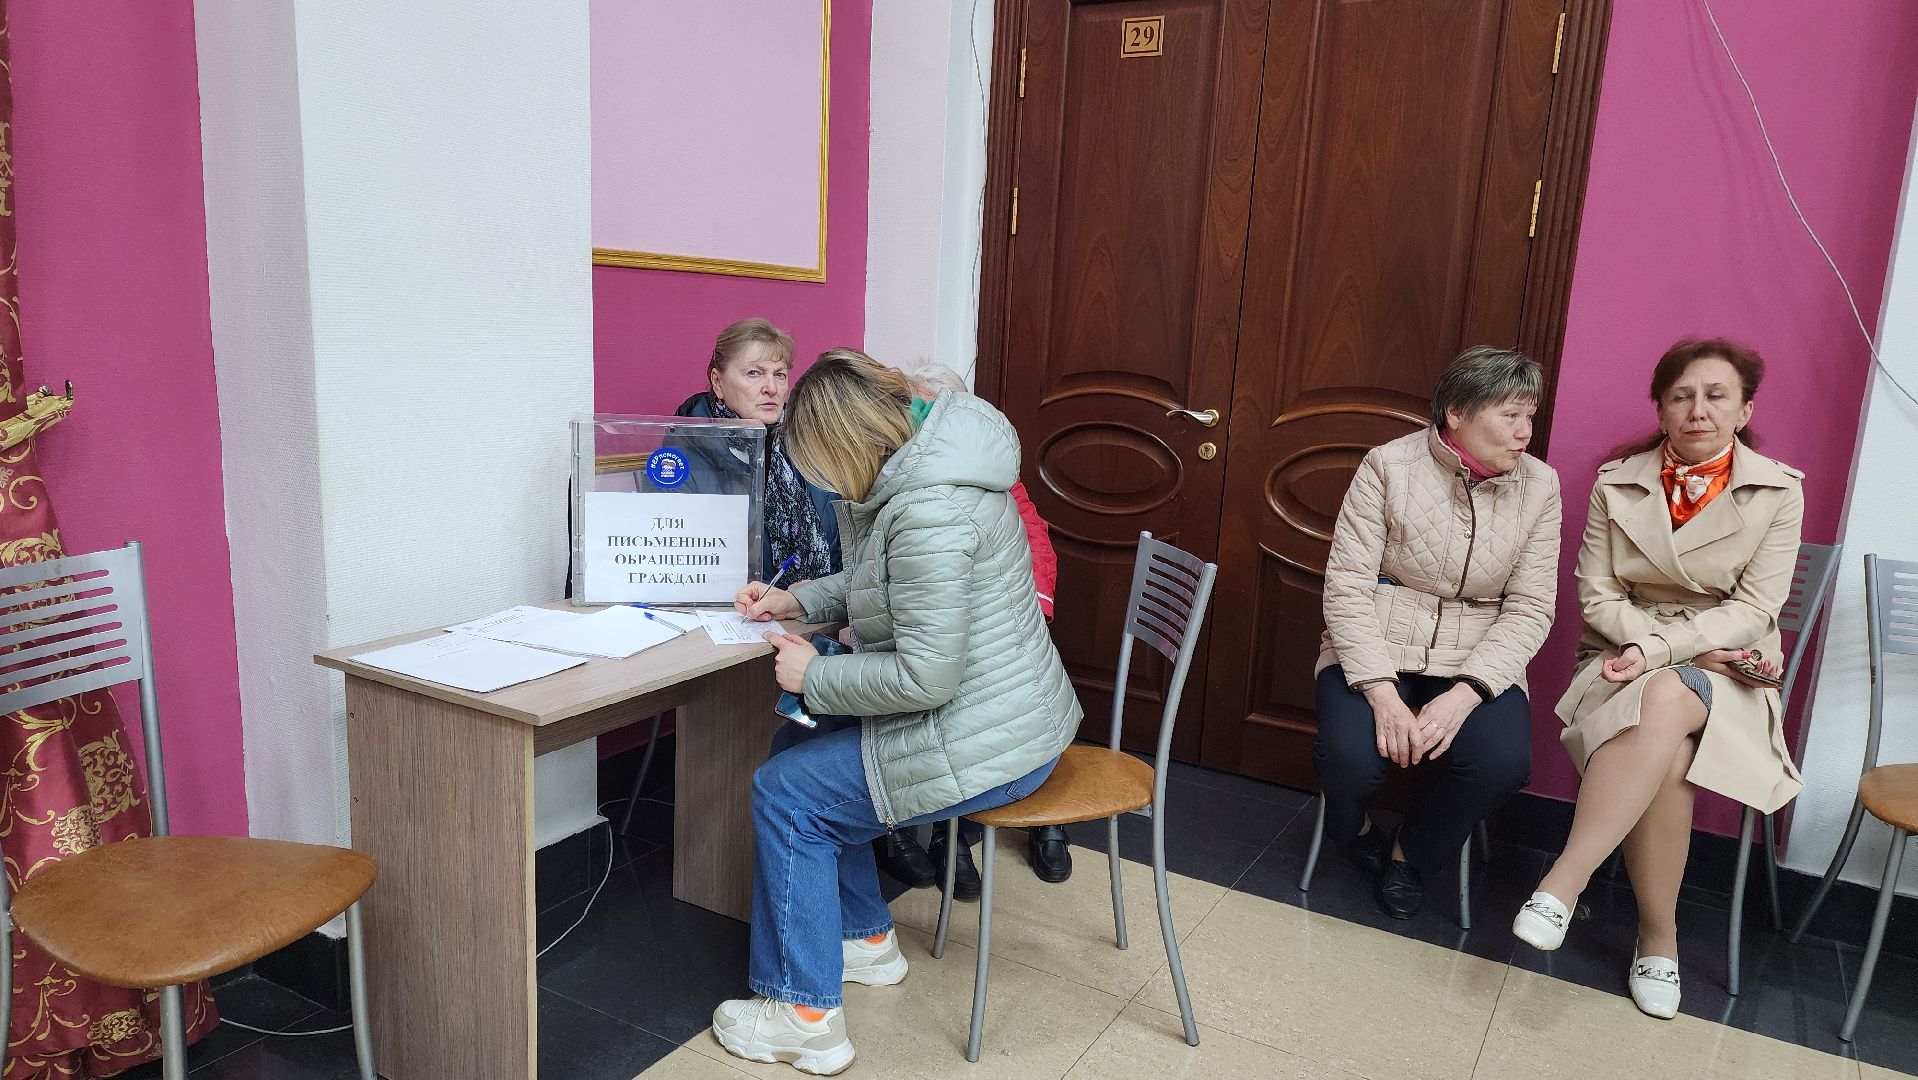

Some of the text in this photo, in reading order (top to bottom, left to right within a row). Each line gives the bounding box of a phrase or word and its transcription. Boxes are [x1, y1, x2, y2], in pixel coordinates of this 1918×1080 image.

[1131, 26, 1154, 46] 29
[651, 517, 684, 530] ДЛЯ
[607, 535, 728, 548] ПИСЬМЕННЫХ
[614, 552, 720, 567] ОБРАЩЕНИЙ
[628, 572, 706, 585] ГРАЖДАН
